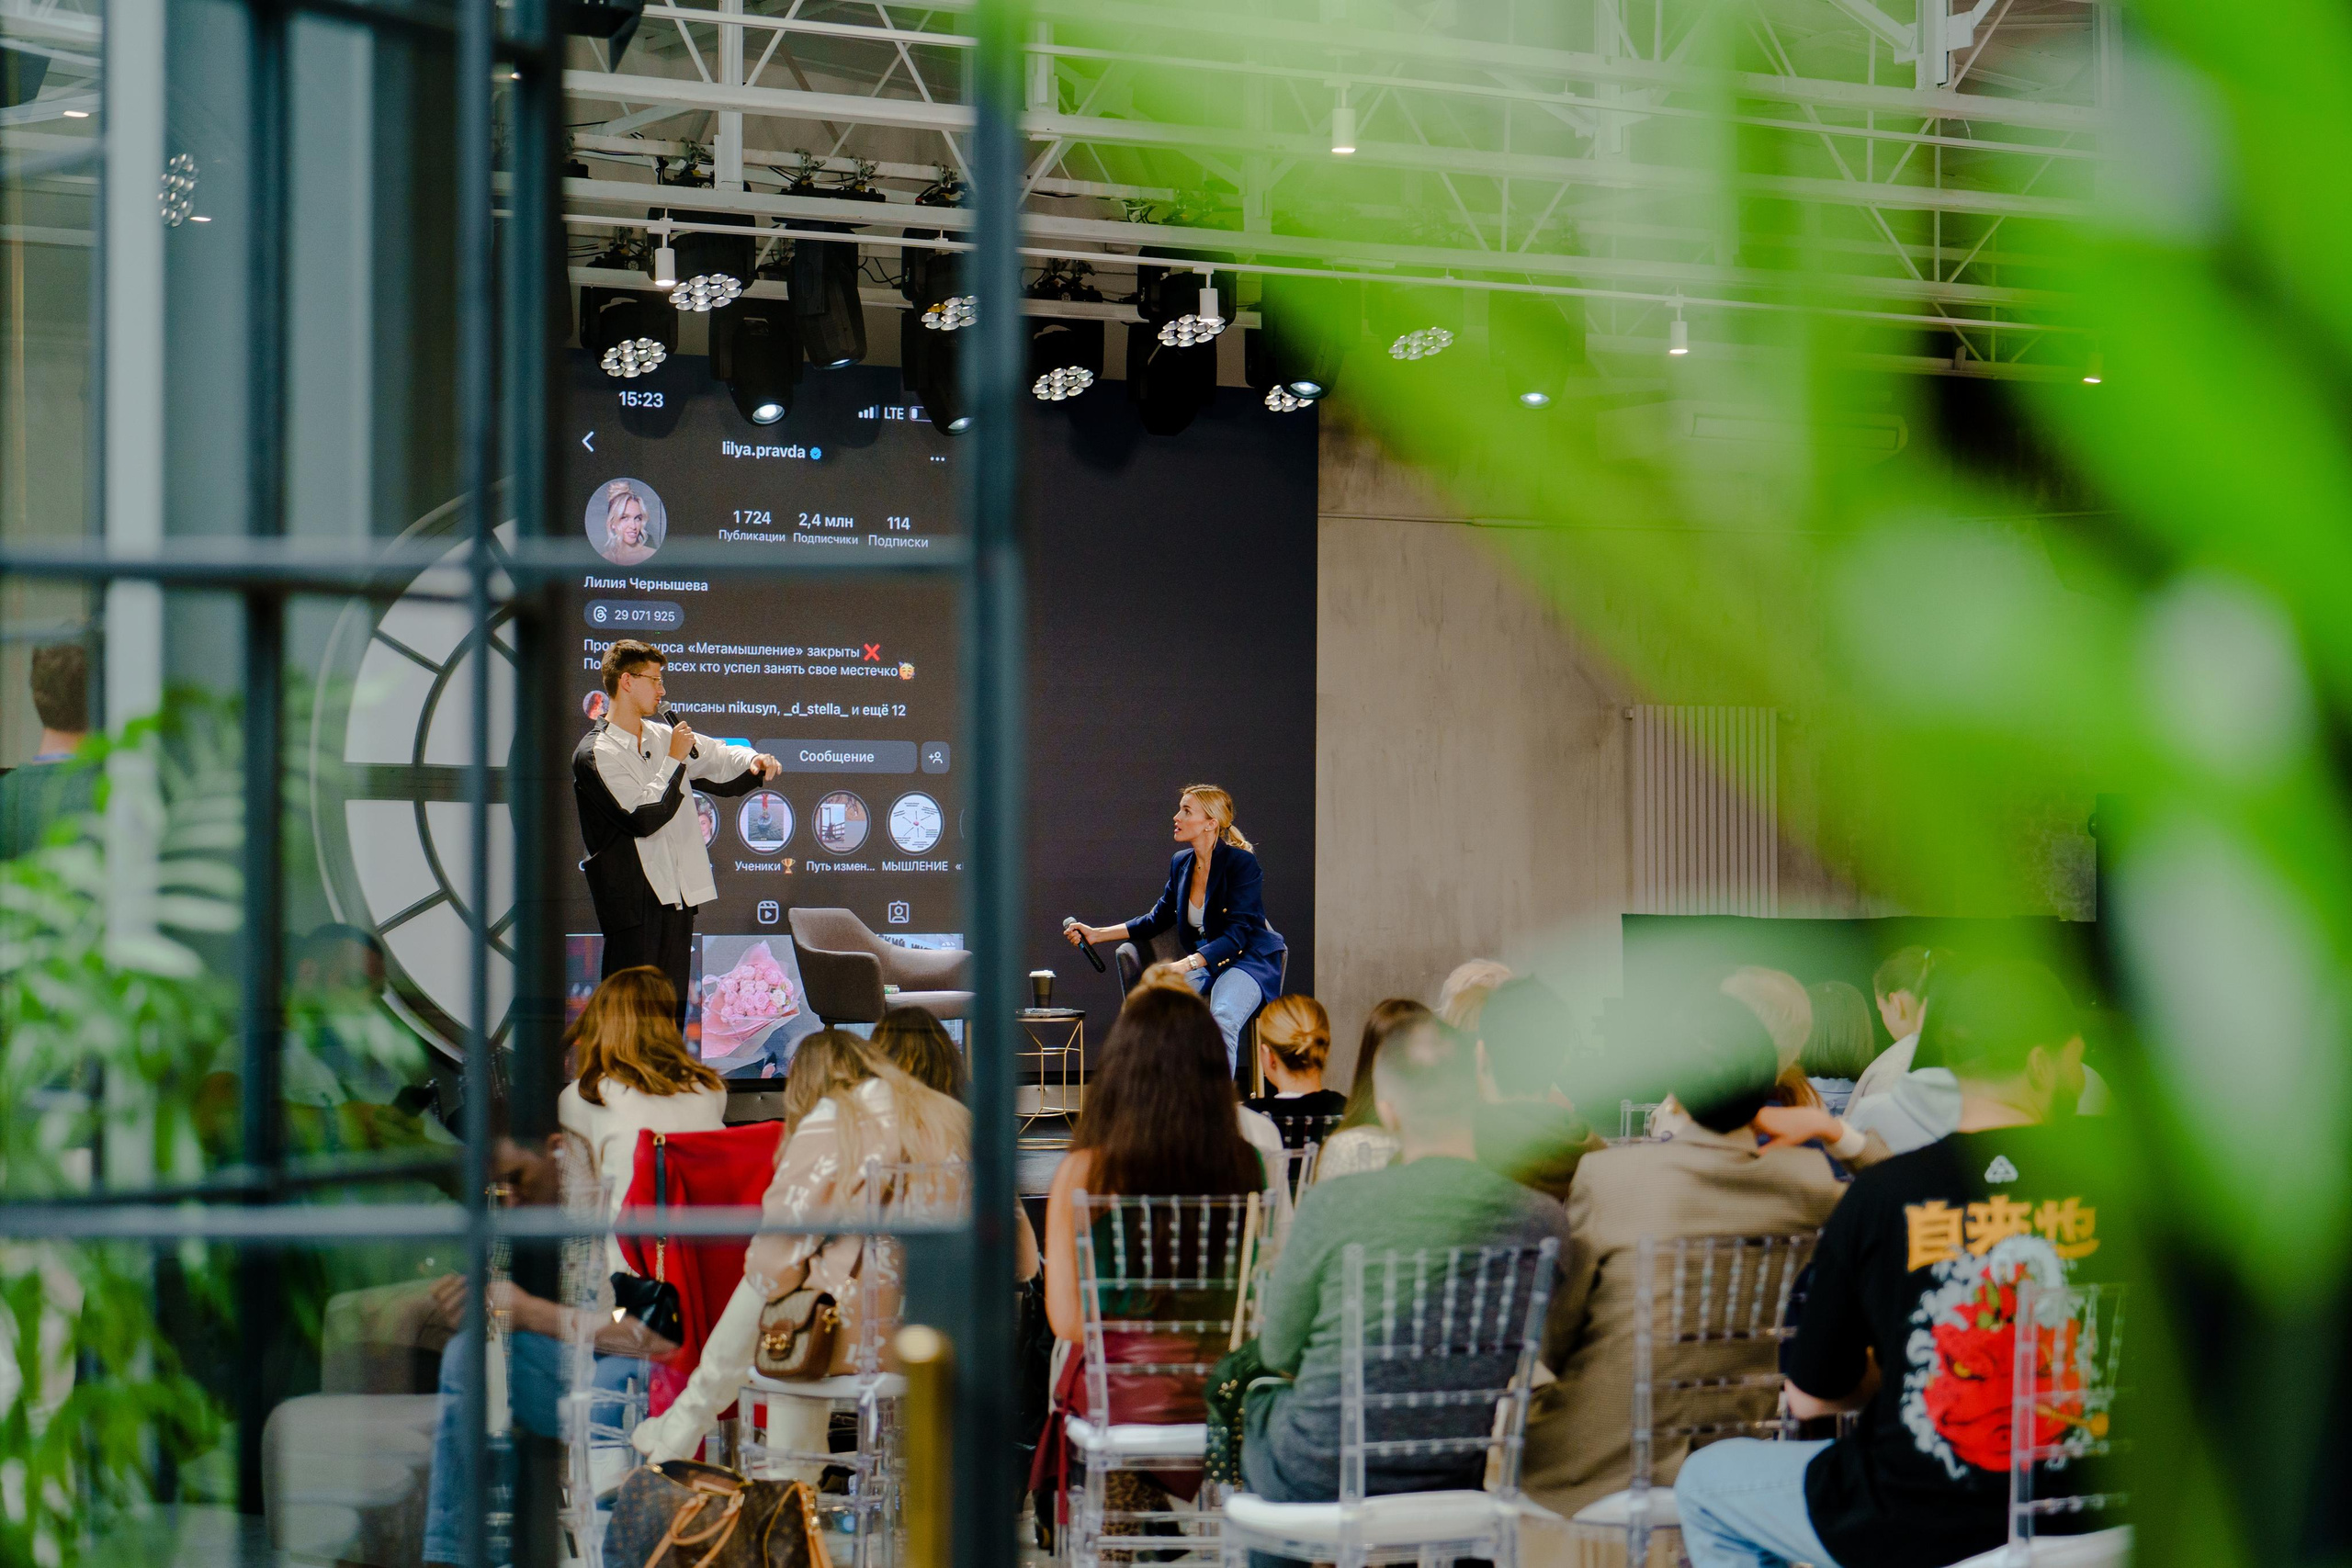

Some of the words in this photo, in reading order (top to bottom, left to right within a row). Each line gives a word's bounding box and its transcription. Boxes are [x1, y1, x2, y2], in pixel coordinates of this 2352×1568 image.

[618, 390, 664, 409] 15:23
[884, 406, 905, 421] LTE
[721, 440, 806, 459] lilya.pravda
[798, 513, 821, 530] 2,4
[824, 516, 854, 528] млн
[887, 516, 910, 531] 114
[718, 529, 786, 544] Публикации
[793, 532, 859, 546] Подписчики
[868, 534, 929, 549] Подписки
[583, 575, 627, 589] Лилия
[628, 577, 708, 592] Чернышева
[687, 641, 803, 657] «Метамышление»
[807, 647, 860, 660] закрыты
[667, 662, 696, 672] всех
[699, 662, 721, 673] кто
[723, 663, 761, 676] успел
[763, 664, 806, 675] занять
[808, 665, 838, 676] свое
[840, 666, 899, 677] местечко
[728, 700, 781, 716] nikusyn,
[783, 702, 849, 718] _d_stella_
[851, 705, 860, 716] и
[862, 704, 889, 718] ещё
[891, 704, 906, 716] 12
[798, 750, 875, 764] Сообщение
[734, 860, 781, 872] Ученики
[806, 861, 831, 874] Путь
[833, 863, 876, 872] измен...
[881, 861, 949, 872] МЫШЛЕНИЕ
